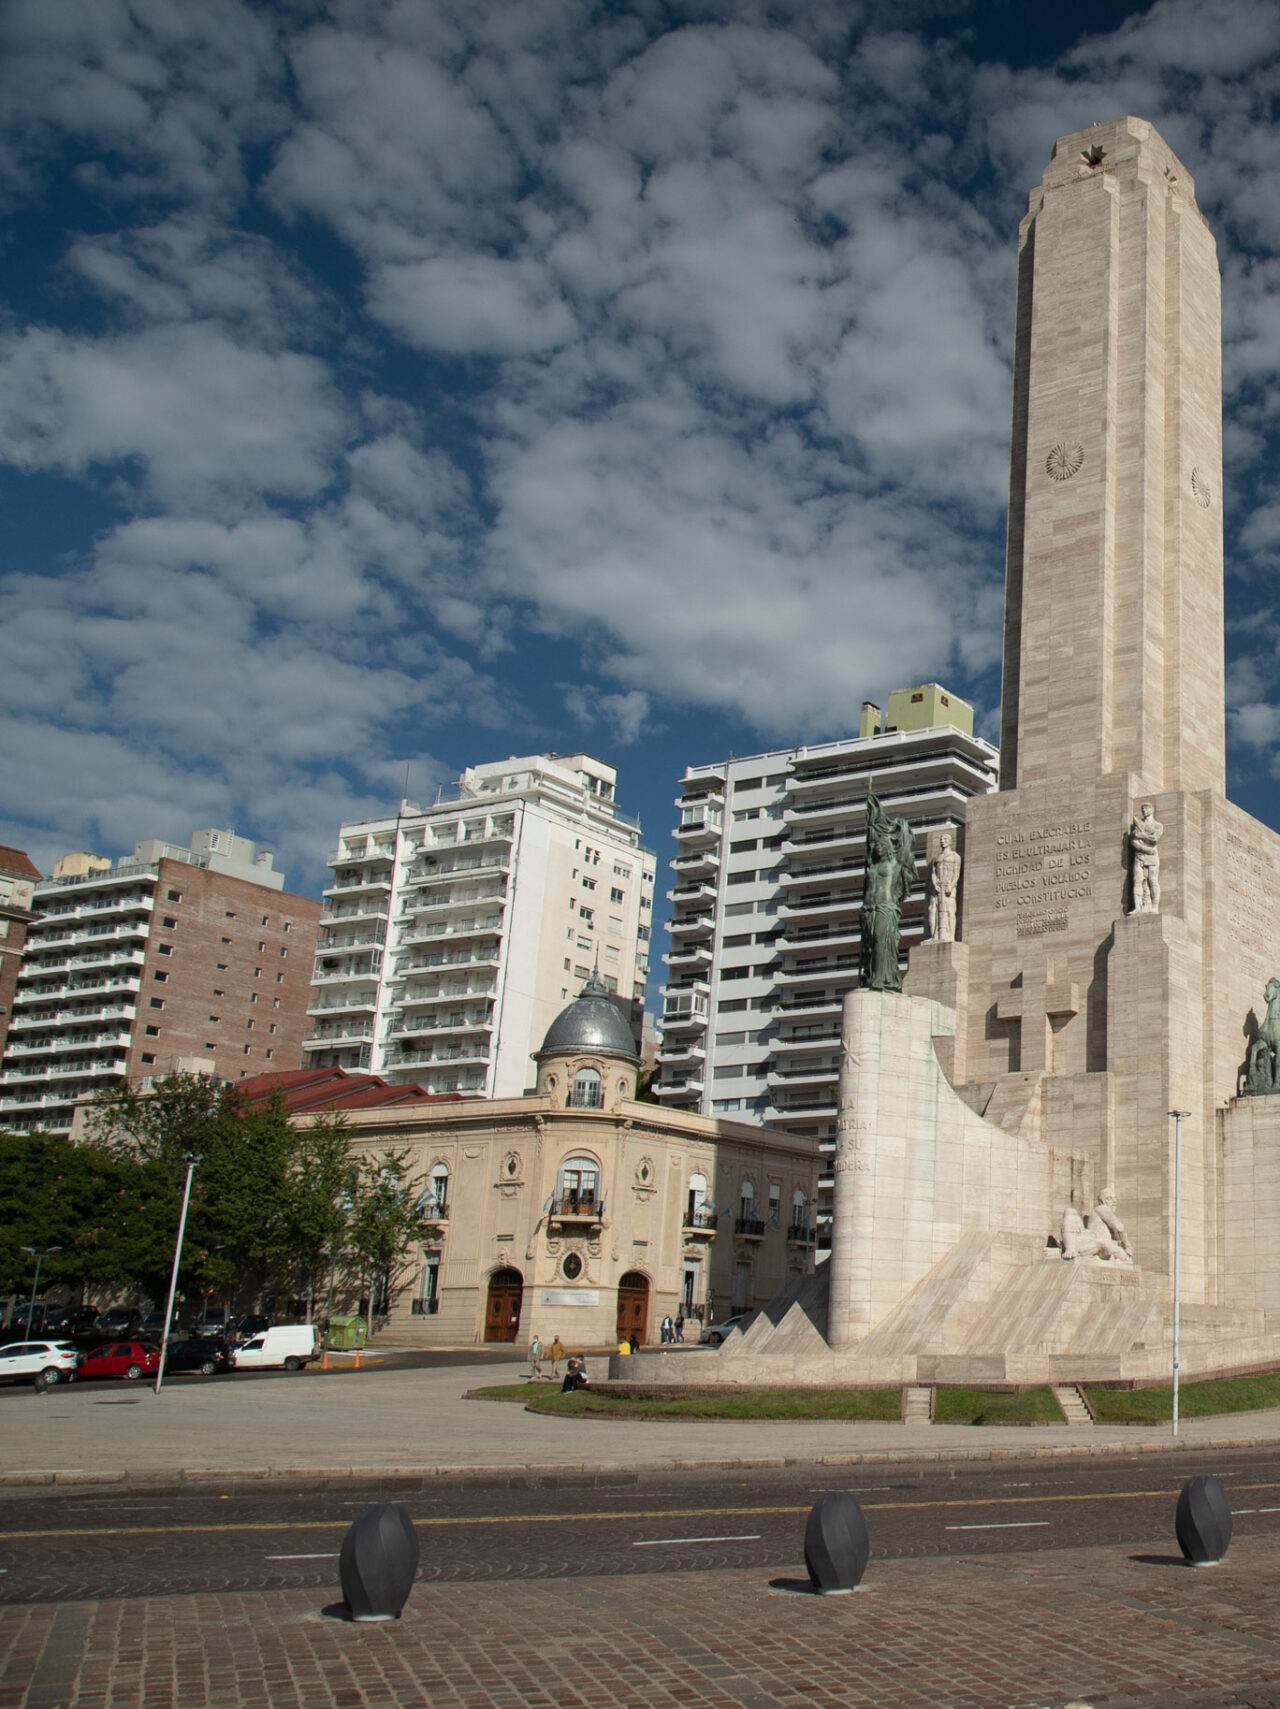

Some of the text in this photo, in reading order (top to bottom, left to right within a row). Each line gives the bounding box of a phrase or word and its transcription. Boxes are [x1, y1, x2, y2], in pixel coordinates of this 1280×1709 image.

[1029, 822, 1090, 841] EXECRABLE
[996, 851, 1009, 862] ES
[1012, 849, 1025, 860] EL
[1078, 839, 1092, 850] LA
[1049, 858, 1064, 869] DE
[1069, 854, 1090, 866] LOS
[995, 878, 1036, 893] PUEBLOS
[994, 898, 1008, 909] SU
